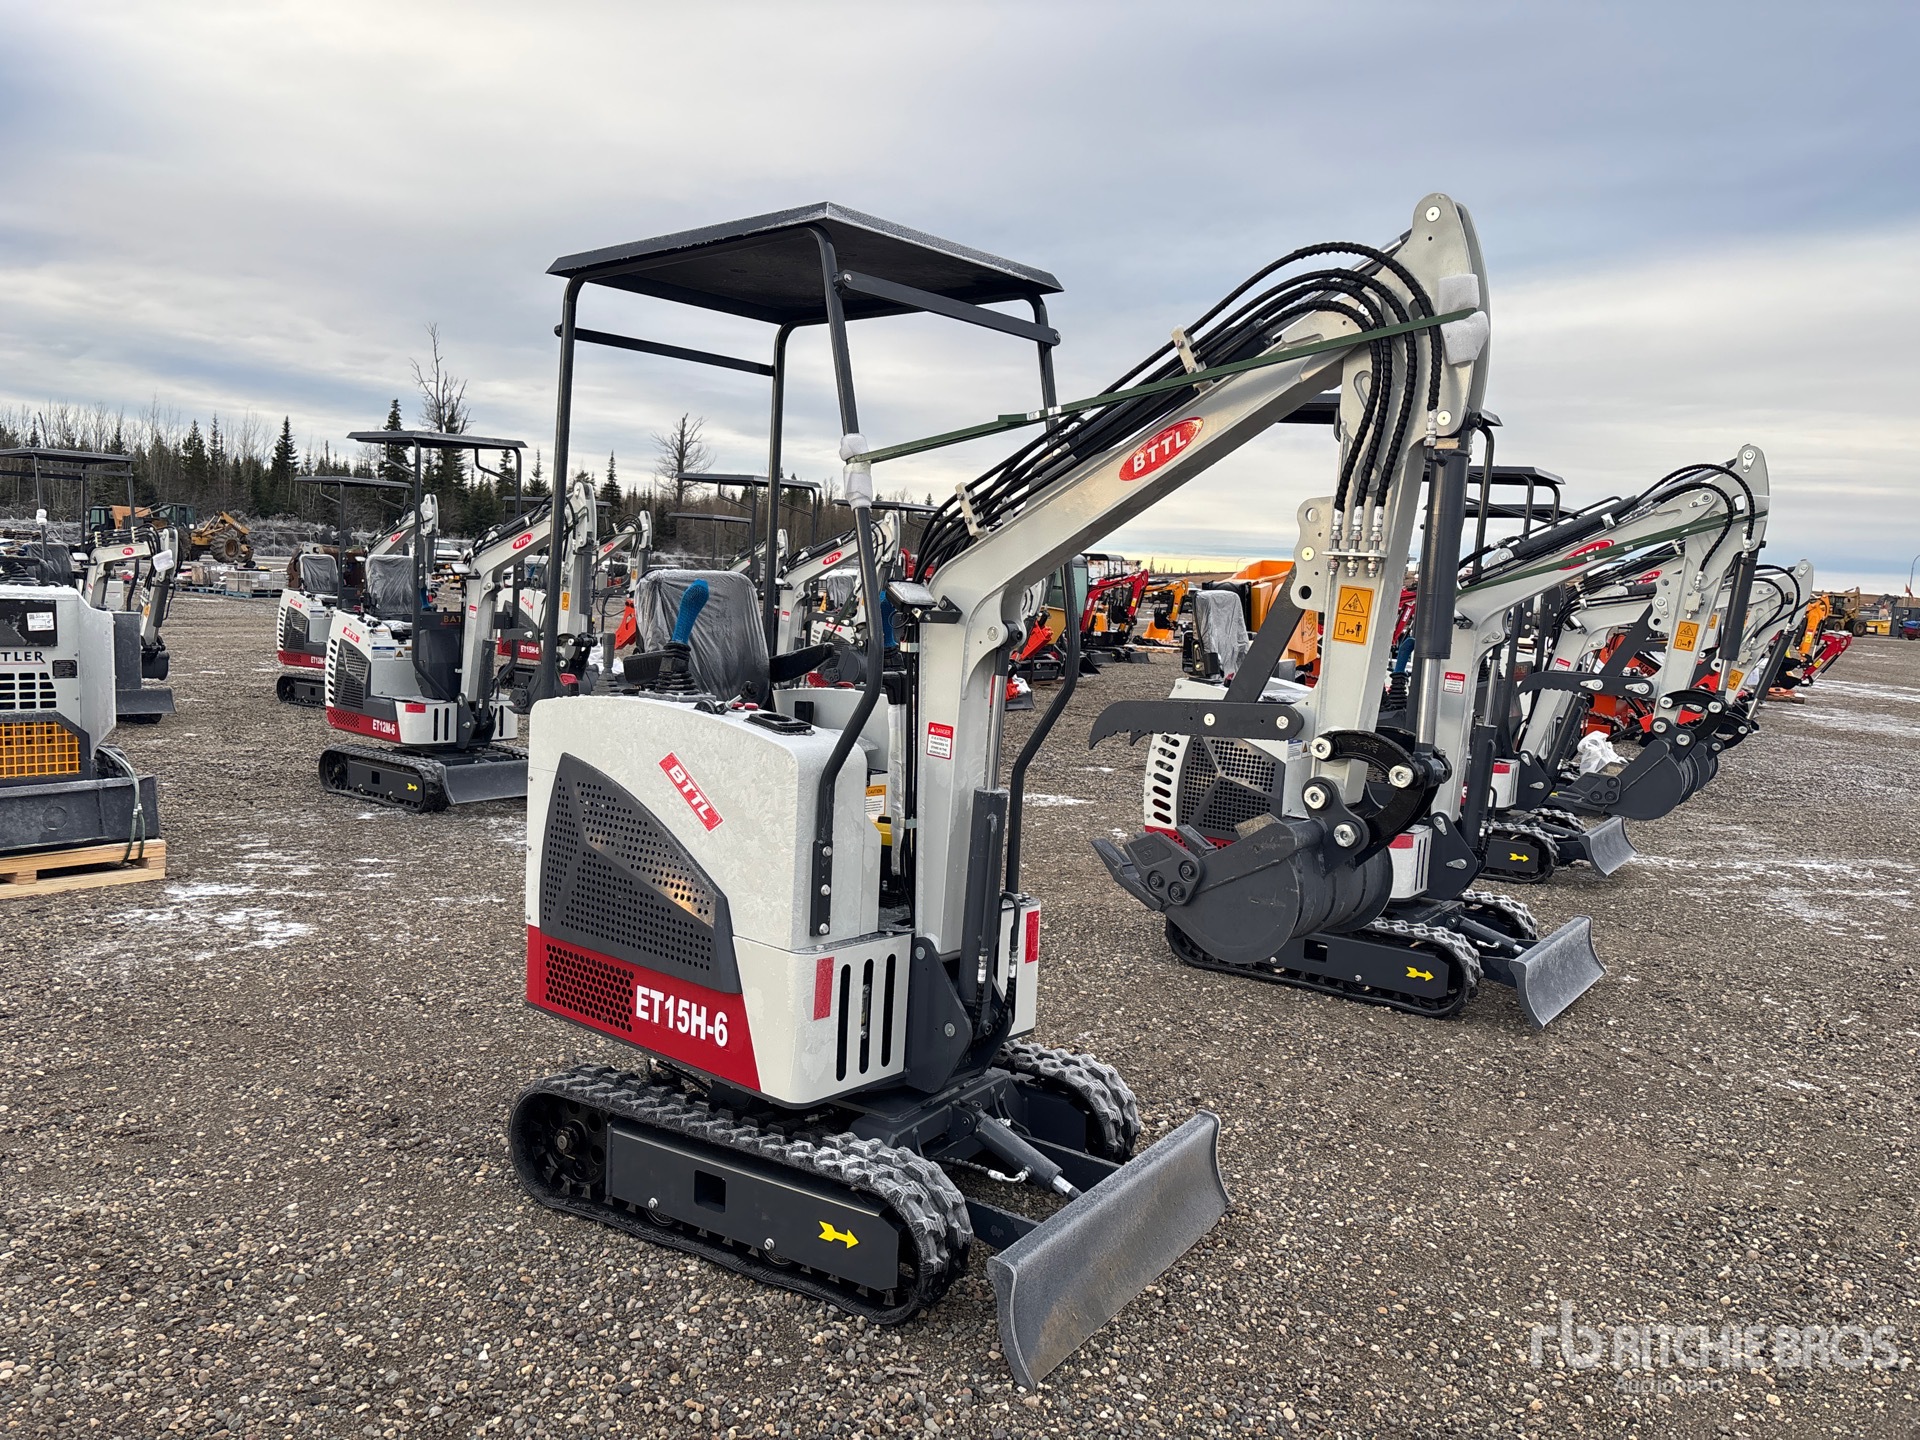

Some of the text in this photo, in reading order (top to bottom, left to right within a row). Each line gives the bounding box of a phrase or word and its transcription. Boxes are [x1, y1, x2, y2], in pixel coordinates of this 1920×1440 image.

[1133, 431, 1186, 473] BTTL
[515, 536, 530, 548] BTTL
[825, 553, 839, 564] BTTL
[372, 719, 395, 735] ET12M-6
[668, 764, 710, 820] BTTL
[636, 985, 728, 1047] ET15H-6
